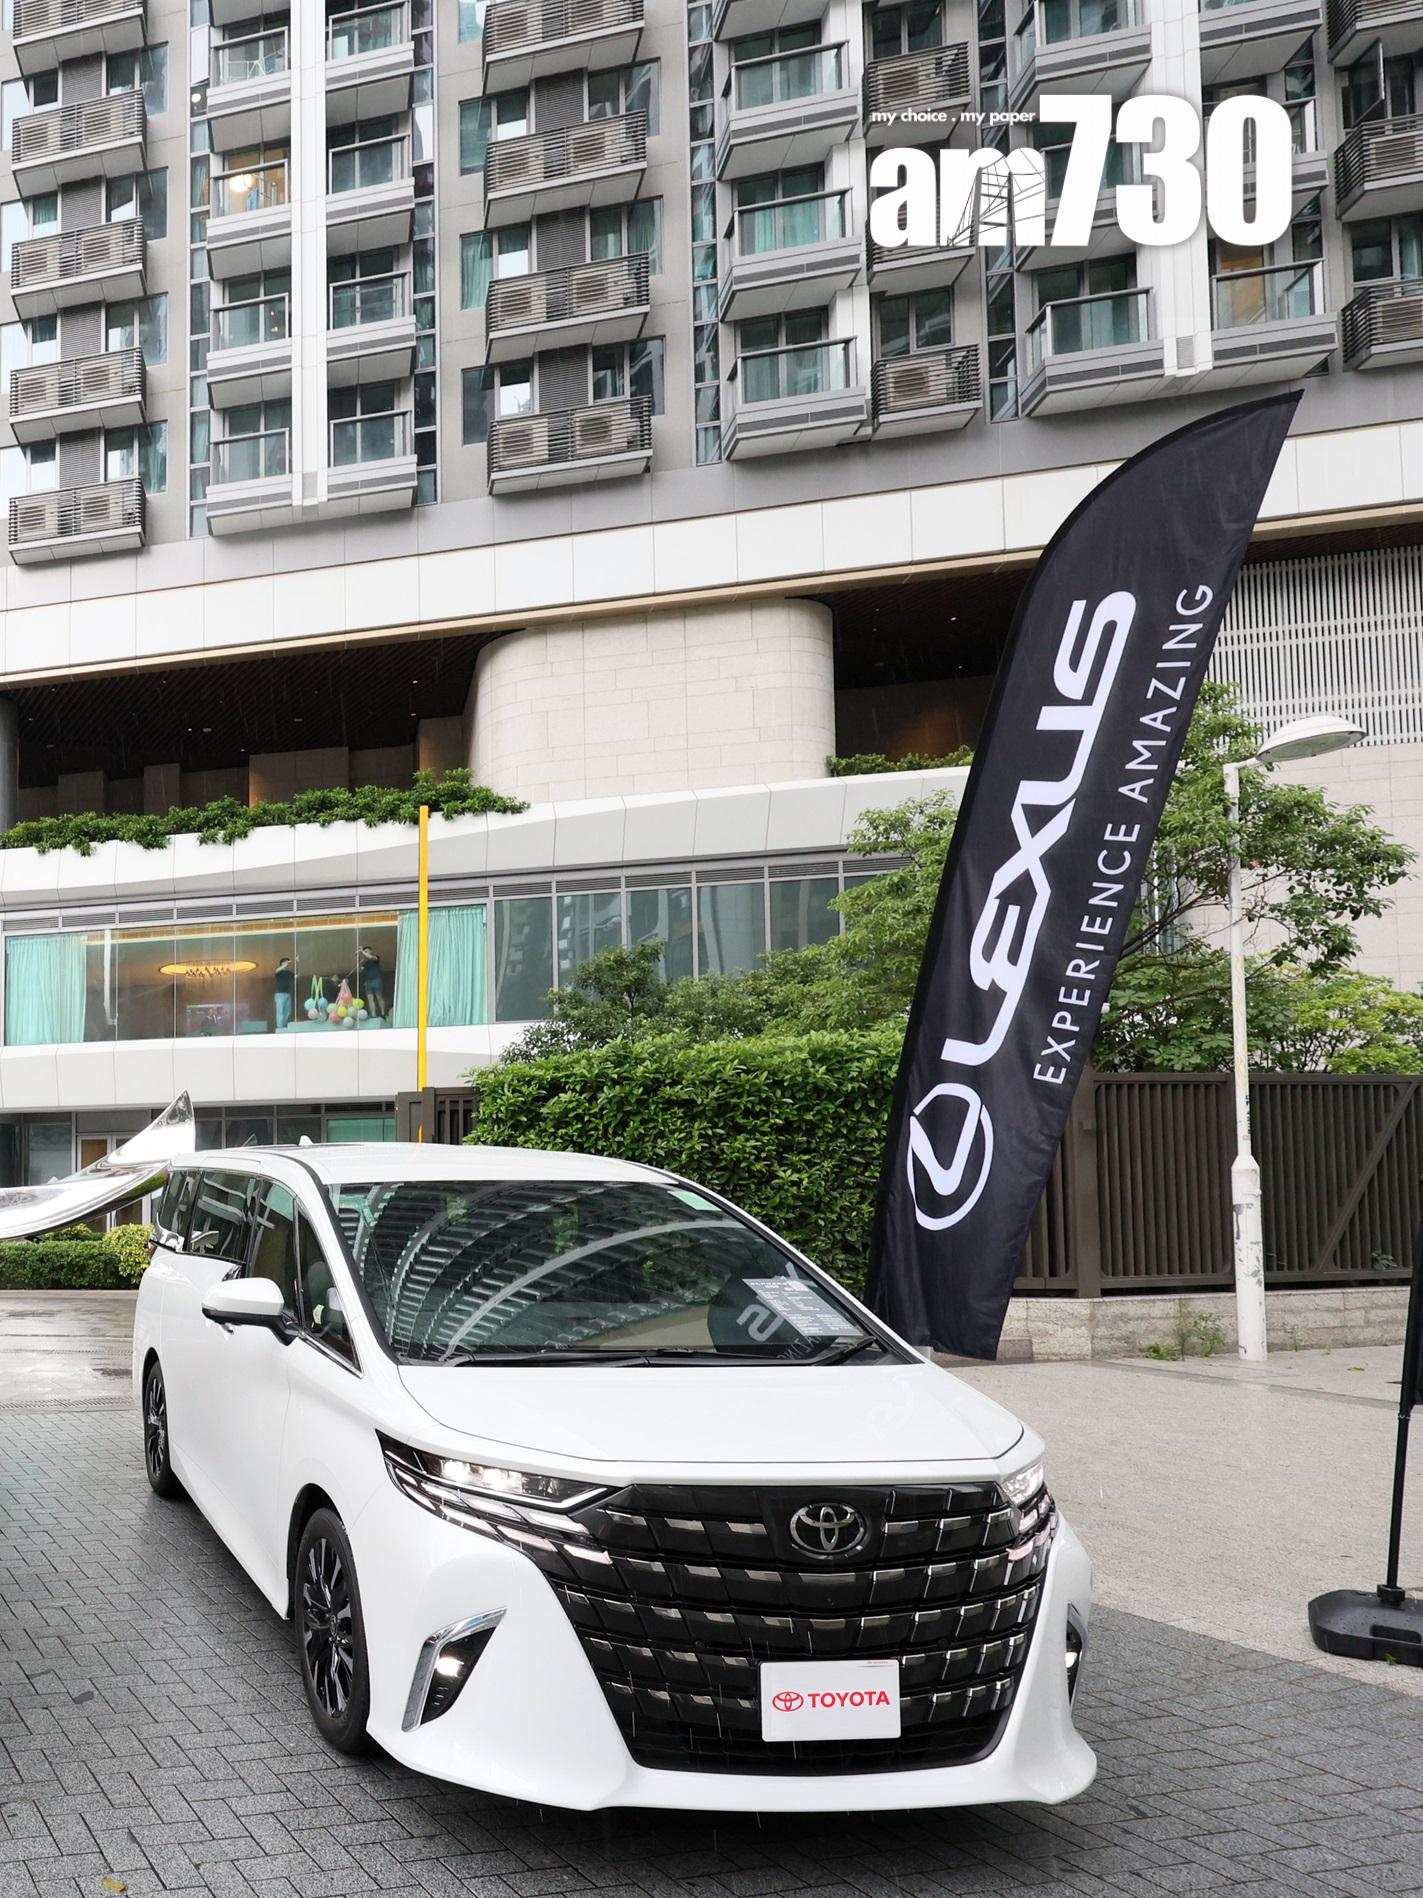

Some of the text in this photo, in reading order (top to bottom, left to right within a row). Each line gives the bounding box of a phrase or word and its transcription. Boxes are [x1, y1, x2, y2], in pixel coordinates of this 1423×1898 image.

[941, 590, 1137, 1067] LEXUS
[1032, 584, 1213, 1085] EXPERIENCE AMAZING
[807, 1691, 890, 1708] TOYOTA
